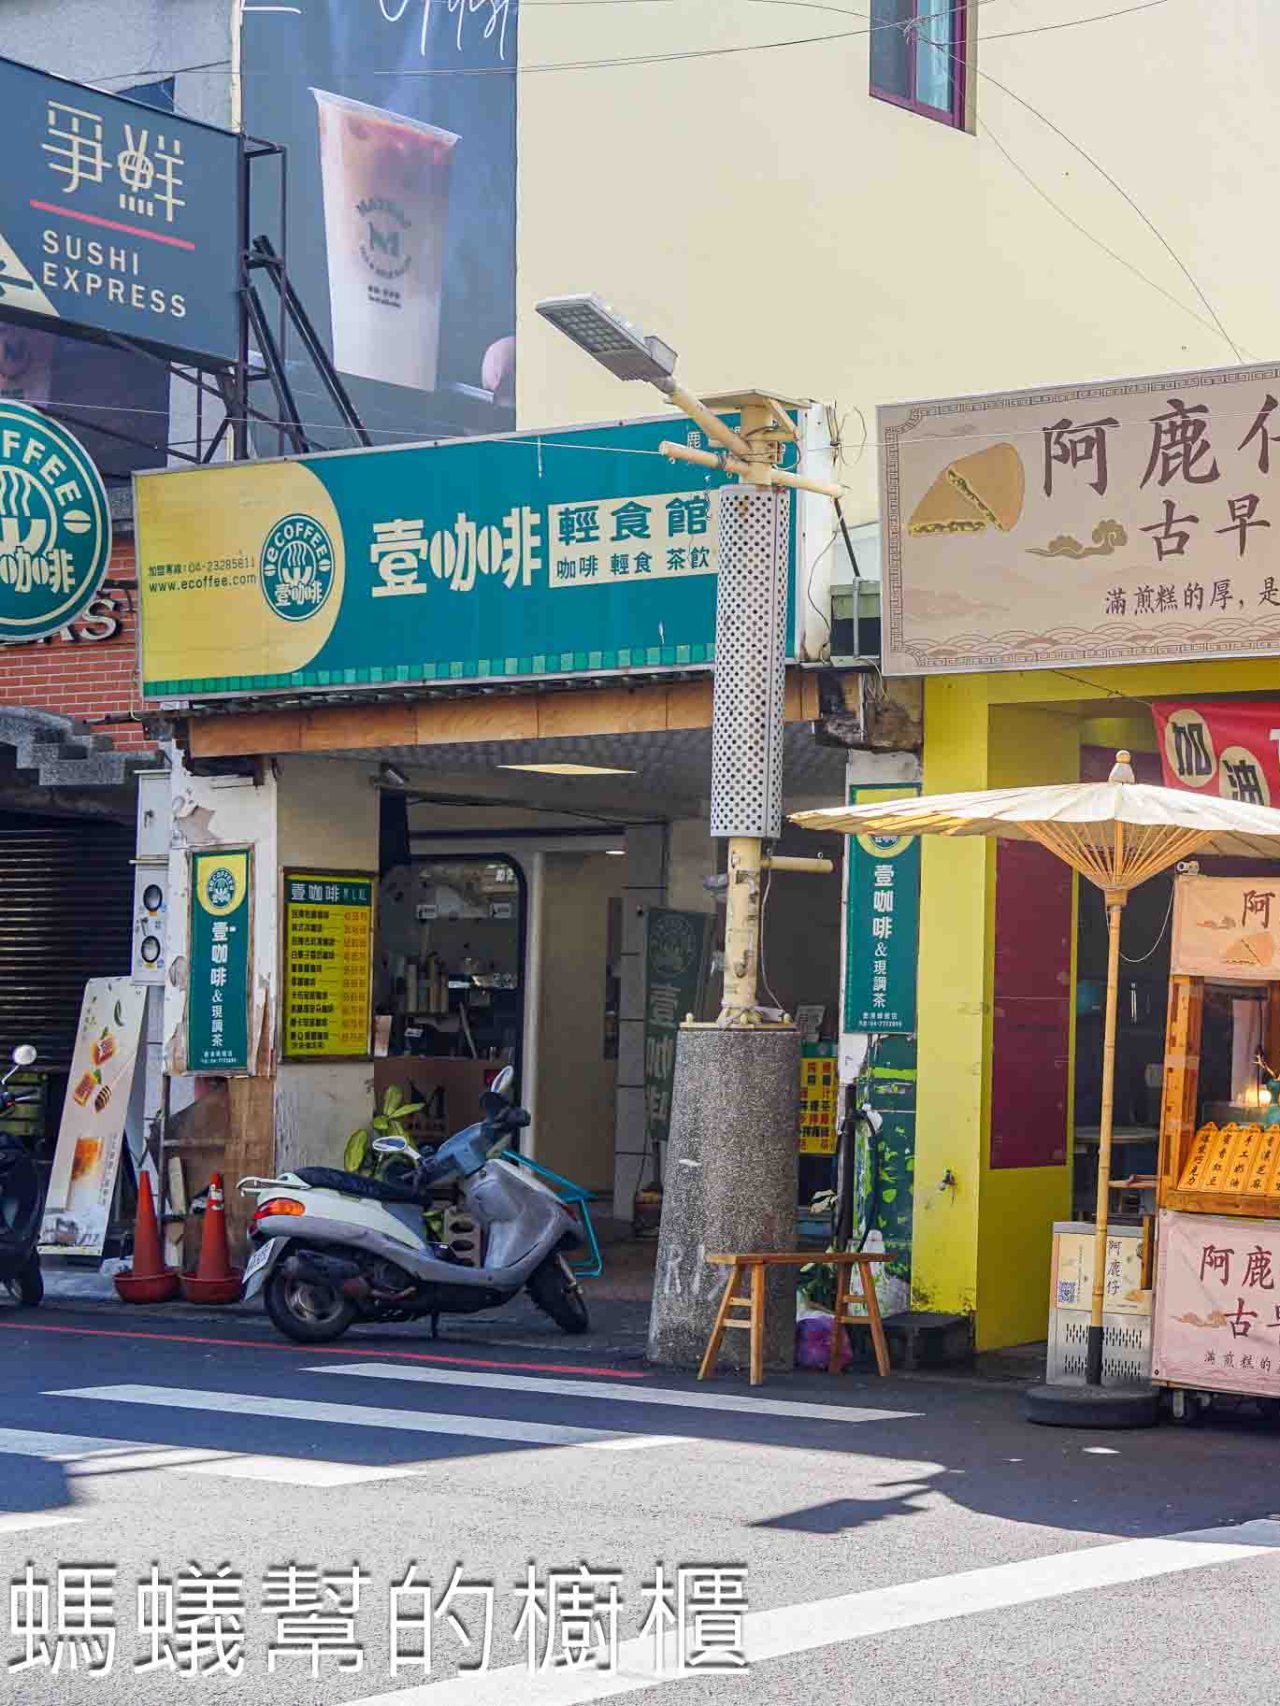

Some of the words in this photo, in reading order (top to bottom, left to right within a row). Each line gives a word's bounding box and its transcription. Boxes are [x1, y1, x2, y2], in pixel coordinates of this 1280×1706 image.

[41, 100, 188, 223] 爭鮮
[43, 229, 141, 276] SUSHI
[43, 262, 188, 318] EXPRESS
[266, 522, 329, 563] eCOFFEE
[557, 495, 710, 547] 輕食館
[370, 506, 542, 599] 壹咖啡
[556, 551, 600, 579] 咖啡
[610, 548, 653, 576] 輕食
[666, 545, 711, 571] 茶飲
[149, 574, 257, 593] www.ecoffee.com
[274, 580, 323, 607] 壹咖啡
